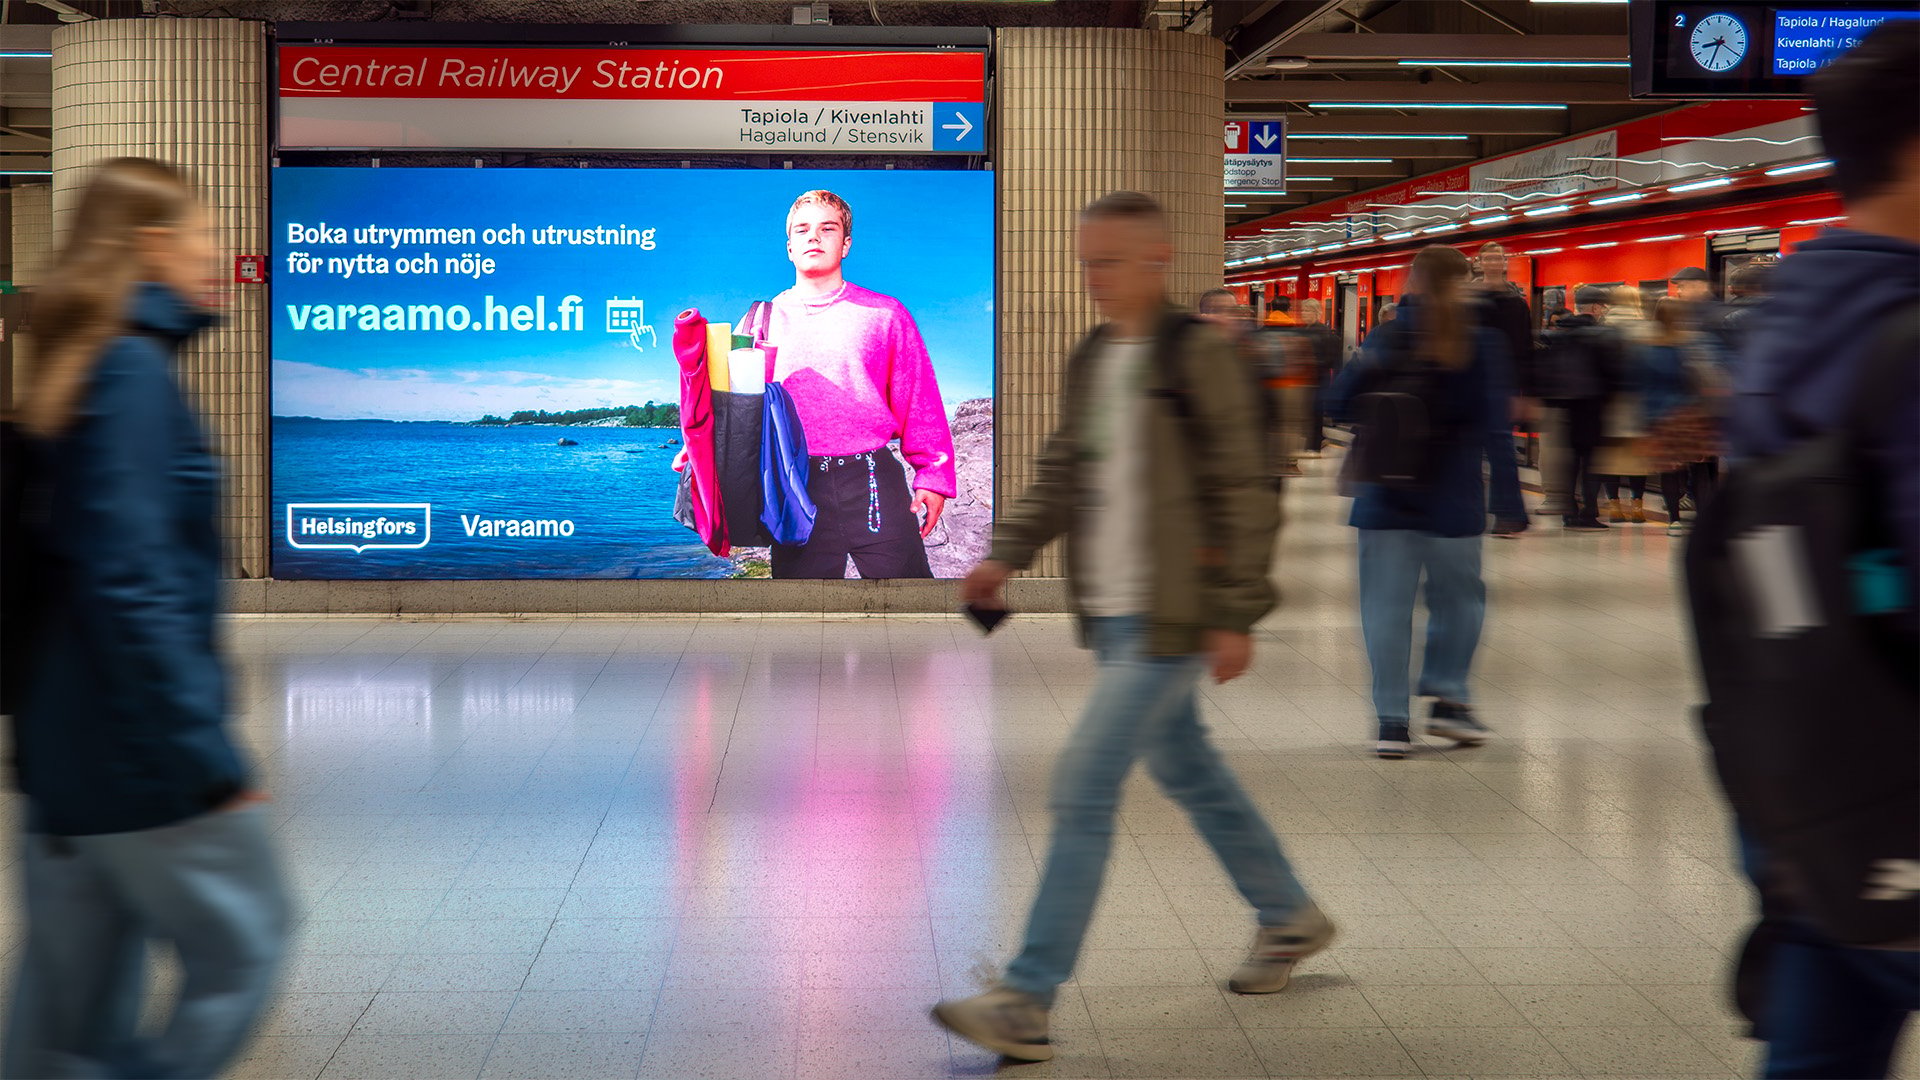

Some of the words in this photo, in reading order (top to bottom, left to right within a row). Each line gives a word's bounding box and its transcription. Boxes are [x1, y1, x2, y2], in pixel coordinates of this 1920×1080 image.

[1675, 15, 1685, 27] 2
[1777, 16, 1818, 29] Tapiola
[1820, 17, 1827, 28] /
[1777, 37, 1835, 48] Kivenlahti
[1837, 38, 1843, 49] /
[1776, 58, 1816, 71] Tapiola
[291, 56, 428, 94] Central
[438, 57, 582, 94] Railway
[592, 59, 725, 90] Station
[740, 108, 808, 126] Tapiola
[814, 108, 825, 126] /
[831, 108, 924, 125] Kivenlahti
[739, 127, 827, 146] Hagalund
[831, 127, 842, 145] /
[848, 128, 924, 144] Stensvik
[1224, 158, 1273, 168] ätäpysäytys
[1224, 168, 1256, 177] ödstopp
[1224, 178, 1260, 186] mergency
[1261, 177, 1280, 186] Stop
[288, 223, 348, 244] Boka
[354, 225, 476, 249] utrymmen
[482, 223, 525, 245] och
[532, 225, 656, 251] utrustning
[287, 252, 324, 274] för
[329, 254, 389, 279] nytta
[395, 253, 439, 274] och
[445, 253, 496, 280] nöje
[287, 294, 584, 333] varaamo.hel.fi
[301, 517, 416, 539] Helsingfors
[460, 514, 575, 537] Varaamo
